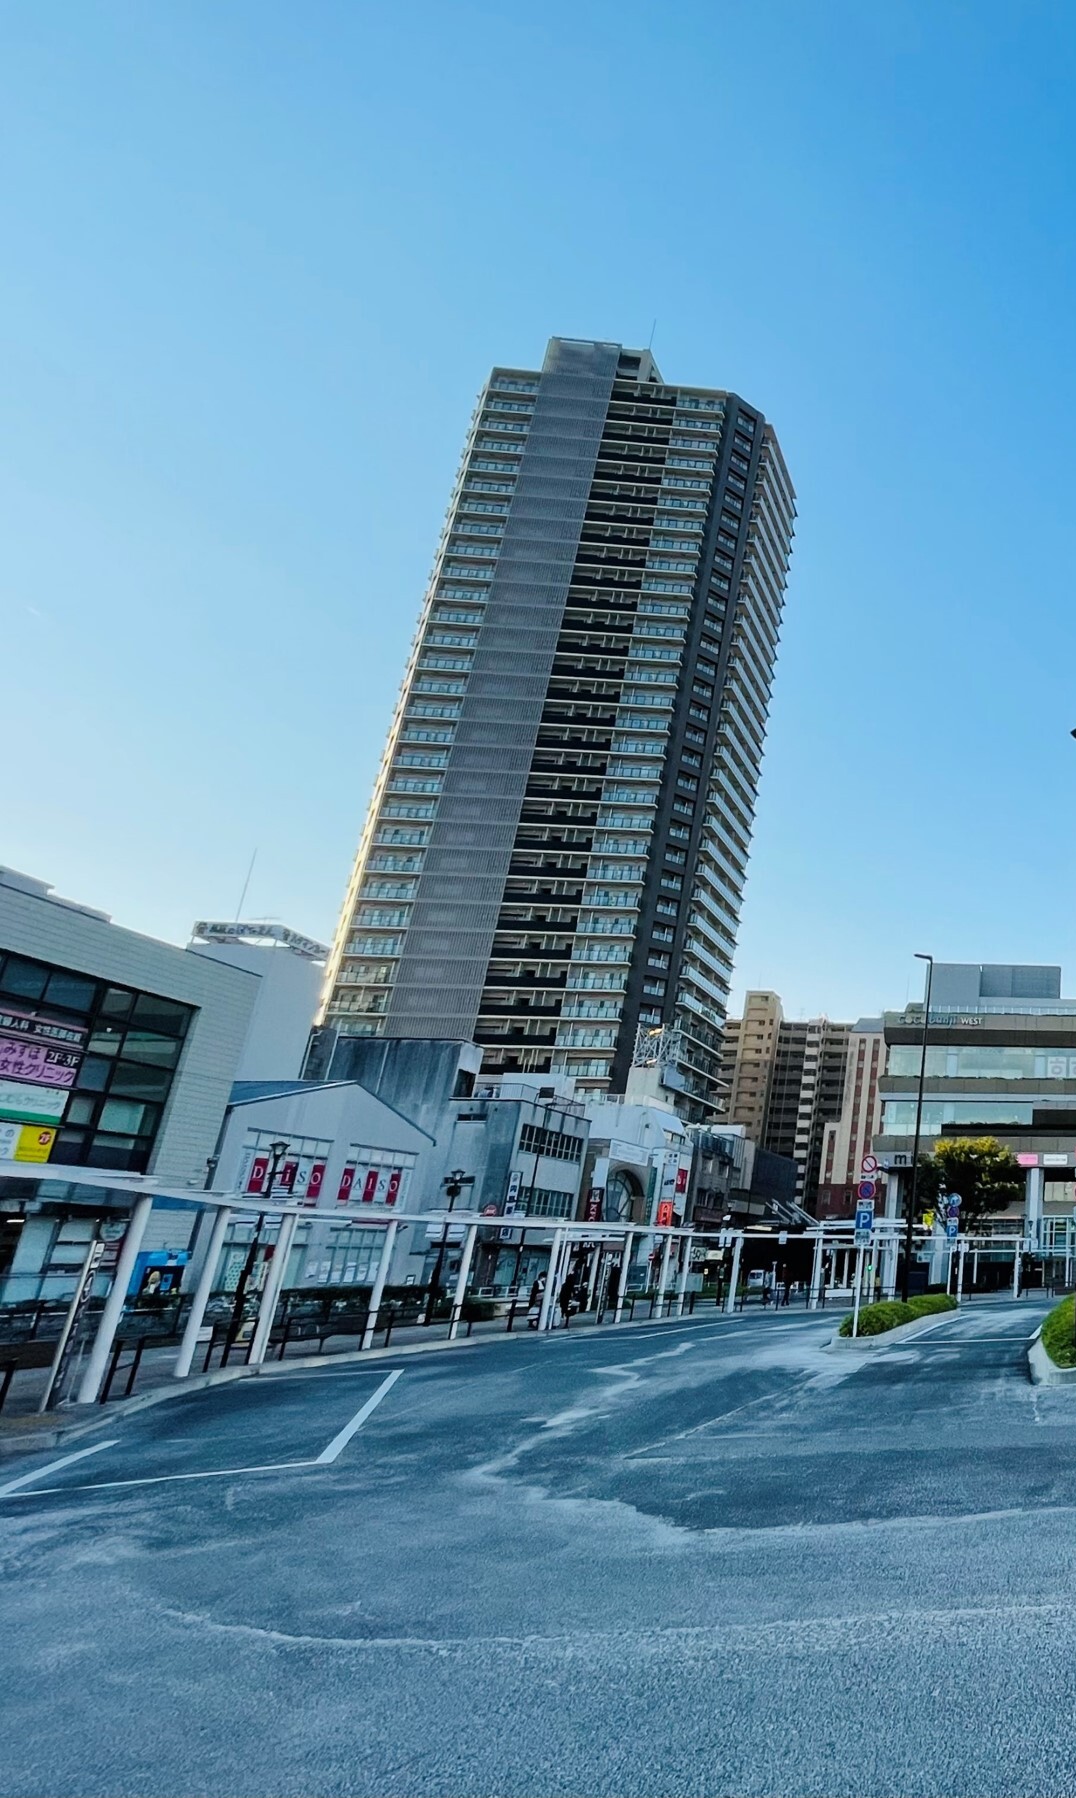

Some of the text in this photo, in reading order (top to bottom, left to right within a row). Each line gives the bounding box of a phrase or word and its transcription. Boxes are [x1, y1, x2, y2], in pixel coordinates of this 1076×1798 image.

[961, 1017, 982, 1026] WEST
[341, 1175, 399, 1192] DAISO
[860, 1213, 870, 1228] P
[949, 1226, 956, 1235] P
